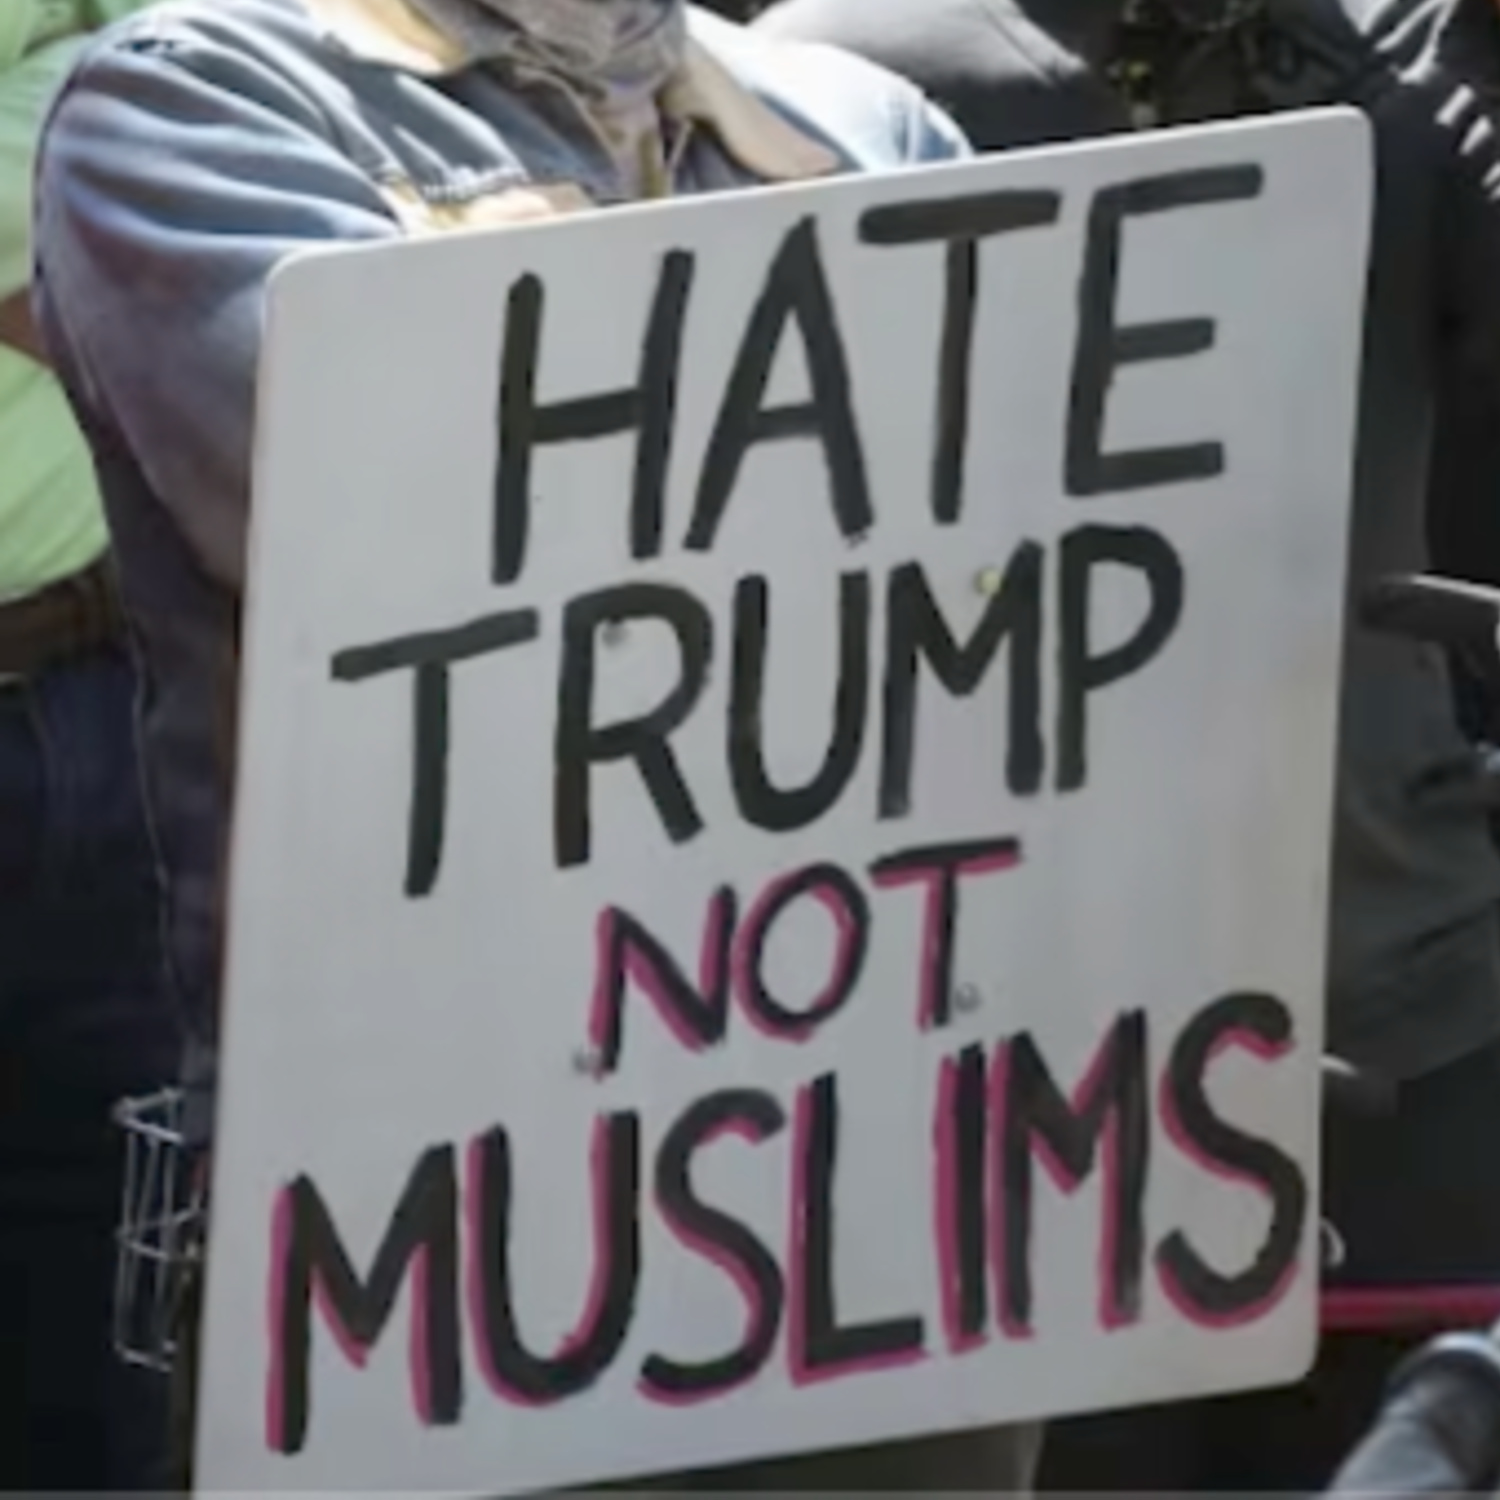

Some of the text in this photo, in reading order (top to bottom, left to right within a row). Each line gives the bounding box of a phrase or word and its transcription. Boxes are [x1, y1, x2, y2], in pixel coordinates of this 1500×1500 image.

[492, 163, 1264, 585] HATE
[331, 522, 1185, 898] TRUMP
[591, 836, 1021, 1078] NOT
[267, 991, 1309, 1456] MUSLIMS
